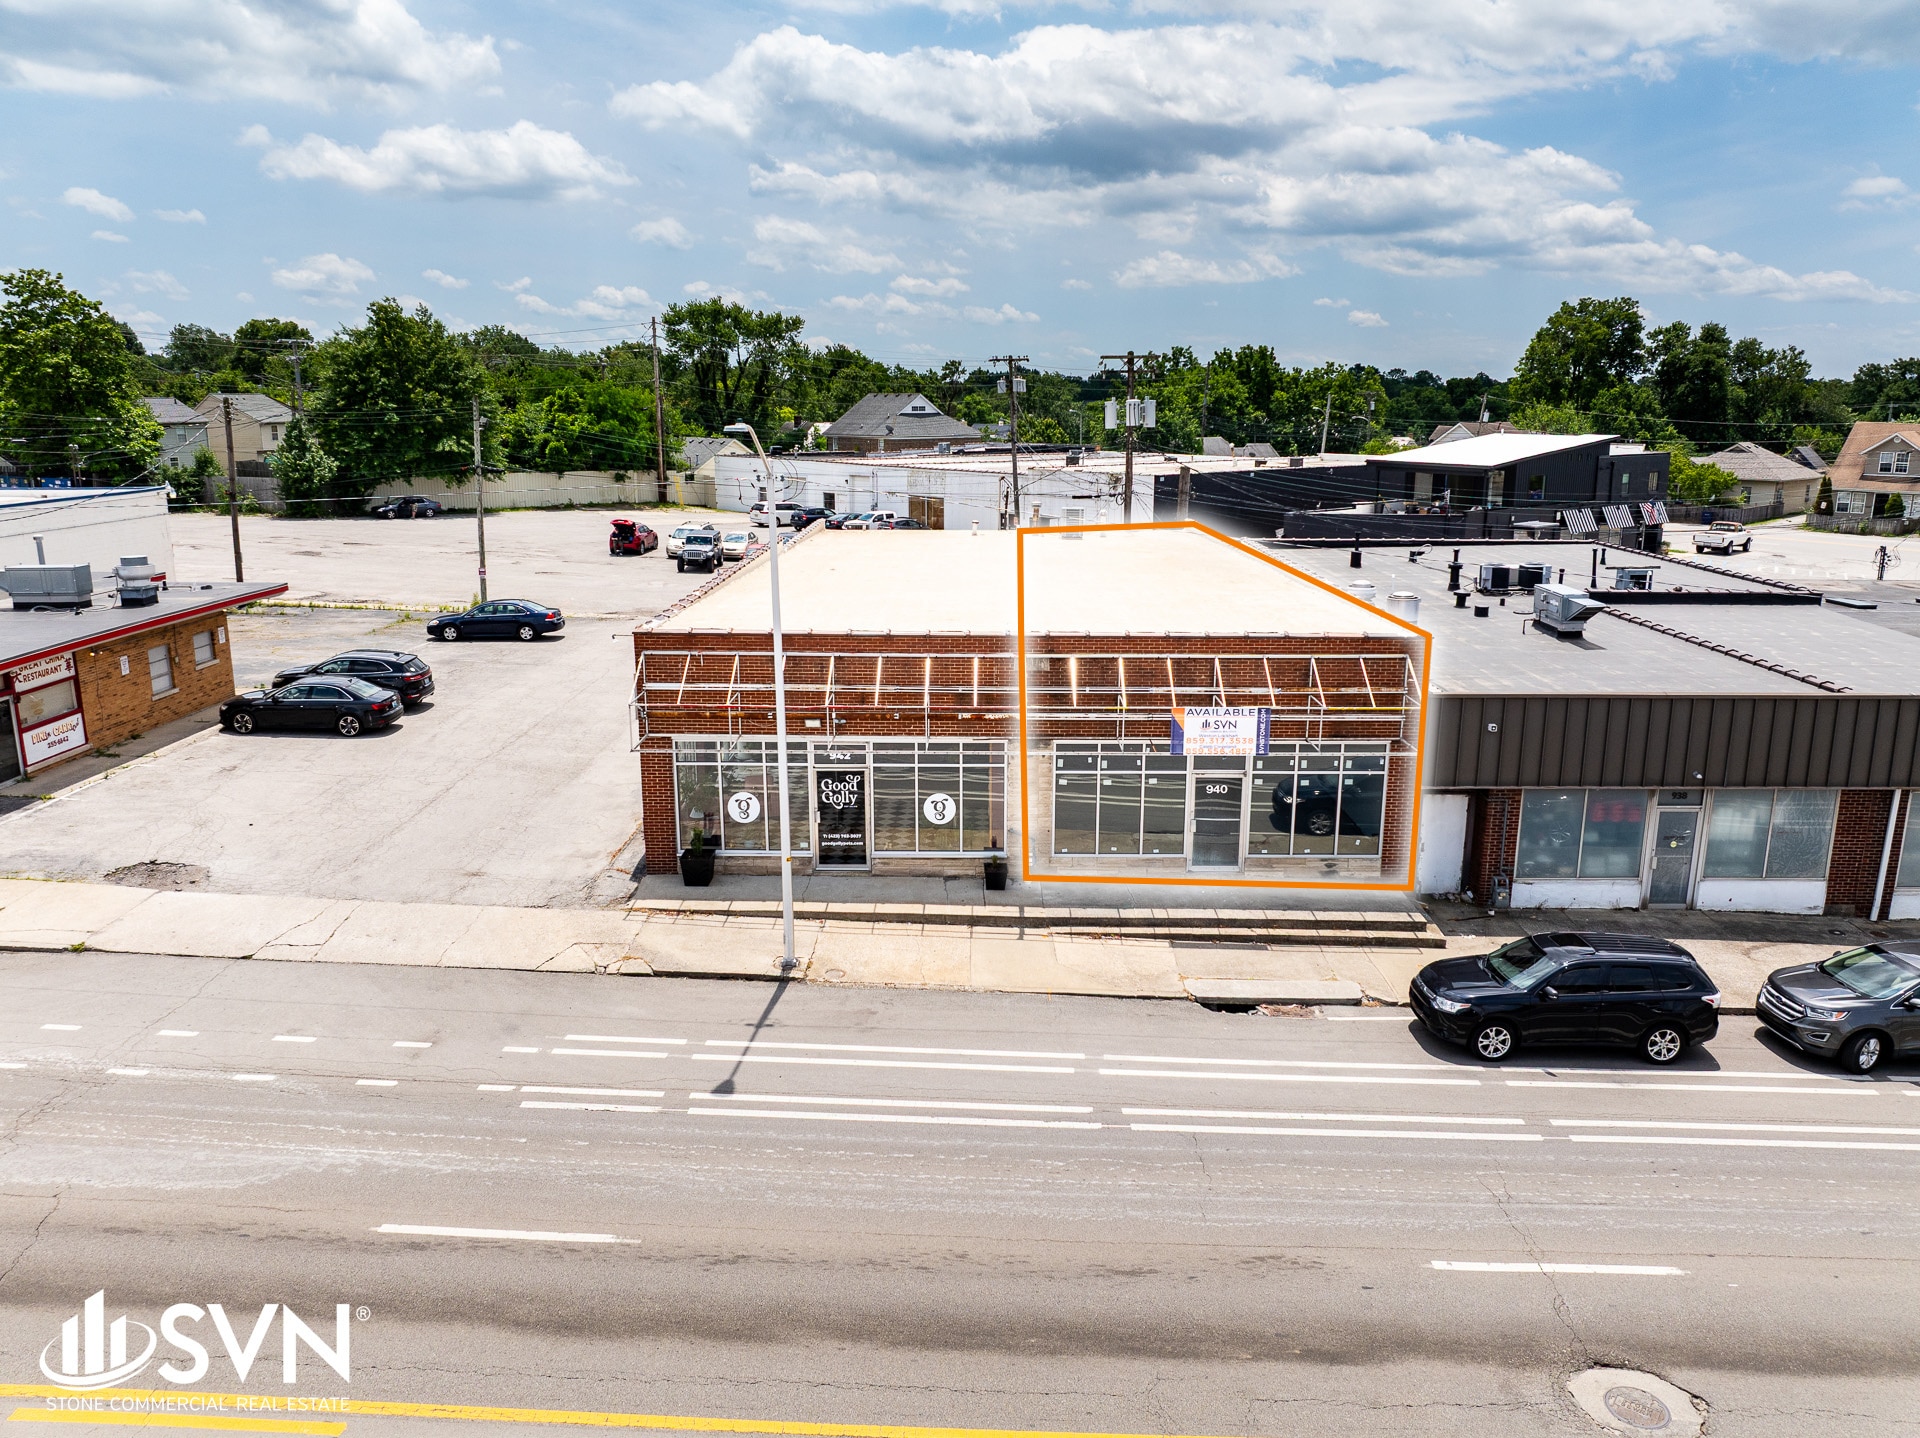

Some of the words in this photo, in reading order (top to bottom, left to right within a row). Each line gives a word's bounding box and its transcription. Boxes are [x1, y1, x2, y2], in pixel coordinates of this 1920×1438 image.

[22, 664, 63, 683] RESTAURANT
[1186, 708, 1256, 717] AVAILABLE
[1213, 719, 1237, 730] SVN
[1259, 708, 1267, 754] SVNSTONE.COM
[1185, 737, 1254, 745] 859.317.3538
[820, 774, 861, 791] Good
[1205, 784, 1229, 794] 940
[821, 790, 858, 810] Golly
[1671, 791, 1688, 800] 938
